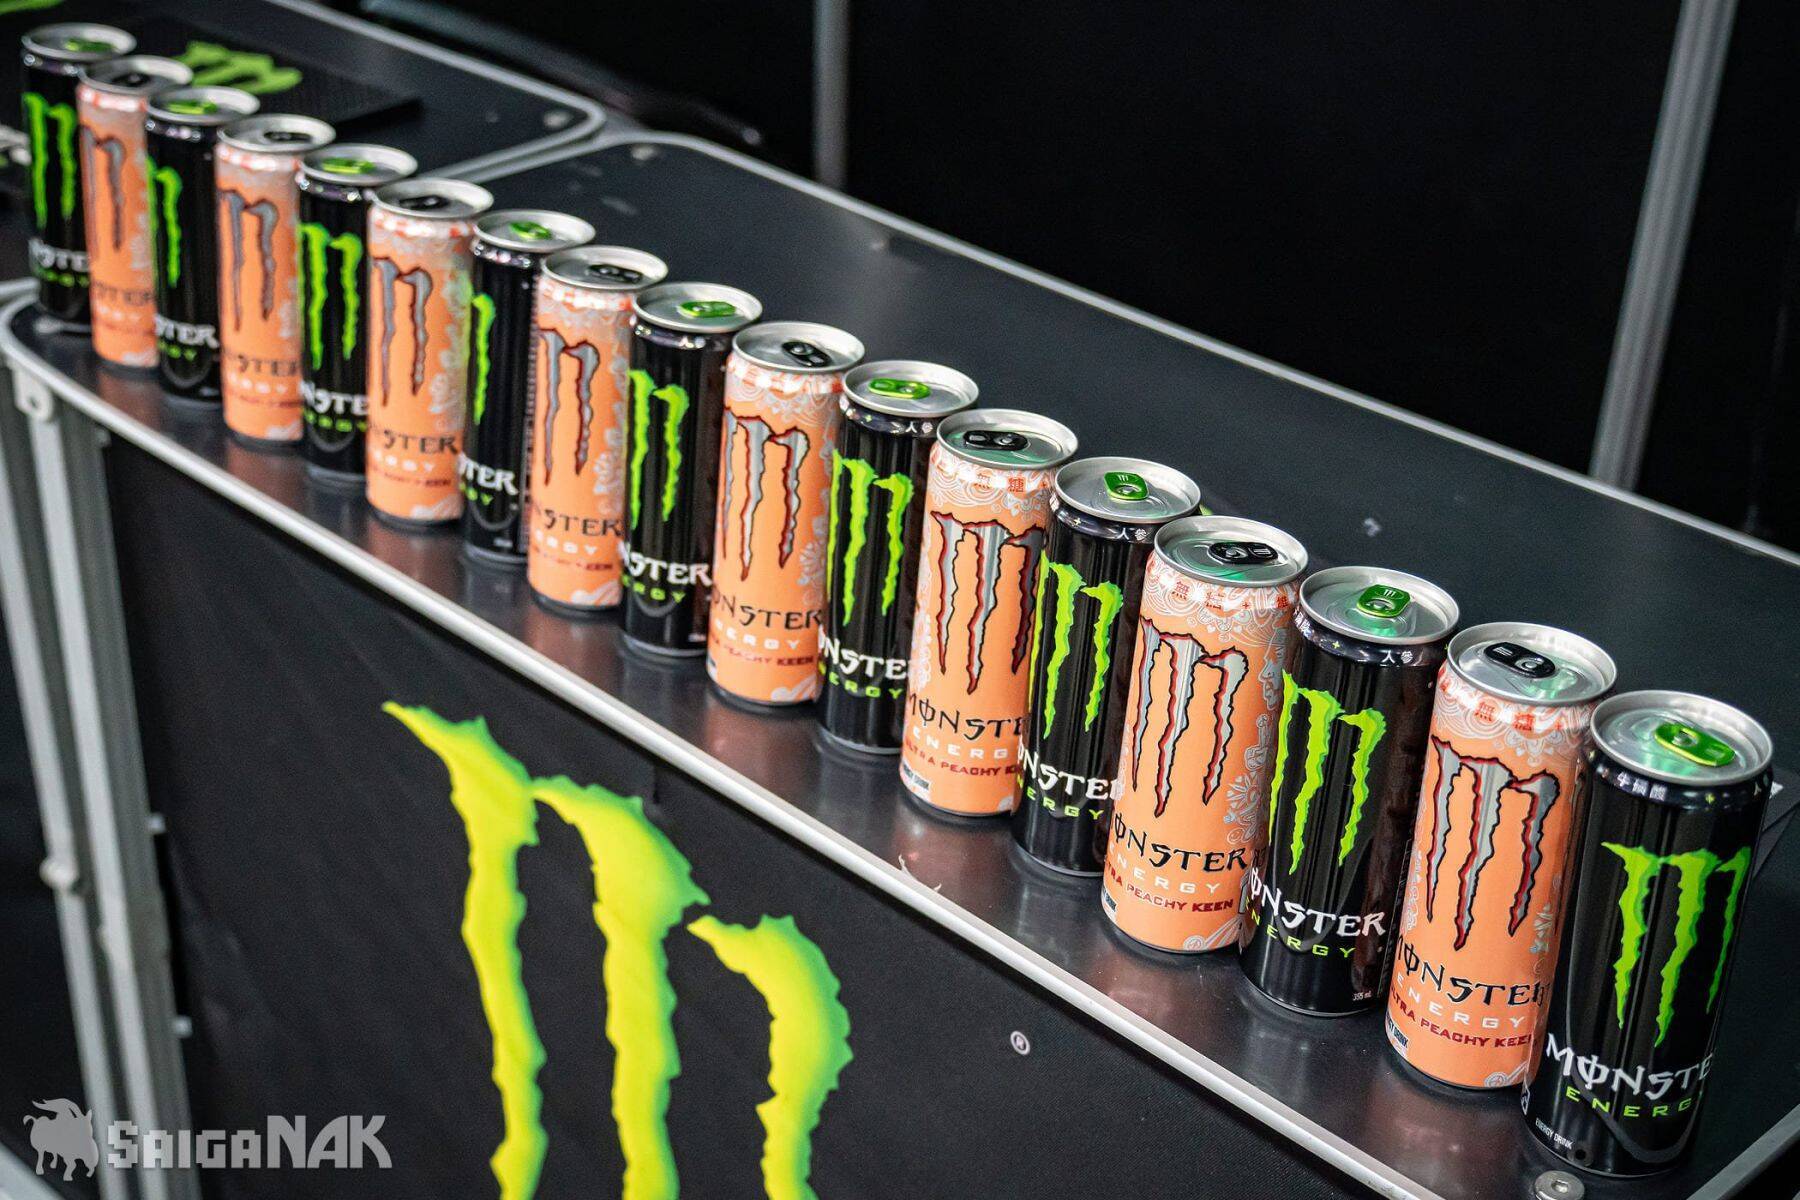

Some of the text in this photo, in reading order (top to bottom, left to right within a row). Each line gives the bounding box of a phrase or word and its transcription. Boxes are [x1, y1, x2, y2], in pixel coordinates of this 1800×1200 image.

[913, 727, 1009, 759] ENERG
[941, 760, 1002, 776] PEACHY
[1114, 812, 1248, 872] ONSTER
[1126, 883, 1187, 911] PEACHY
[1192, 899, 1234, 913] KEEN
[1251, 866, 1386, 937] ONSTER
[1397, 972, 1526, 1029] ENERGY
[1420, 1018, 1490, 1047] PEACHY
[1545, 1032, 1714, 1100] MONSTE
[1566, 1085, 1692, 1117] ENERG
